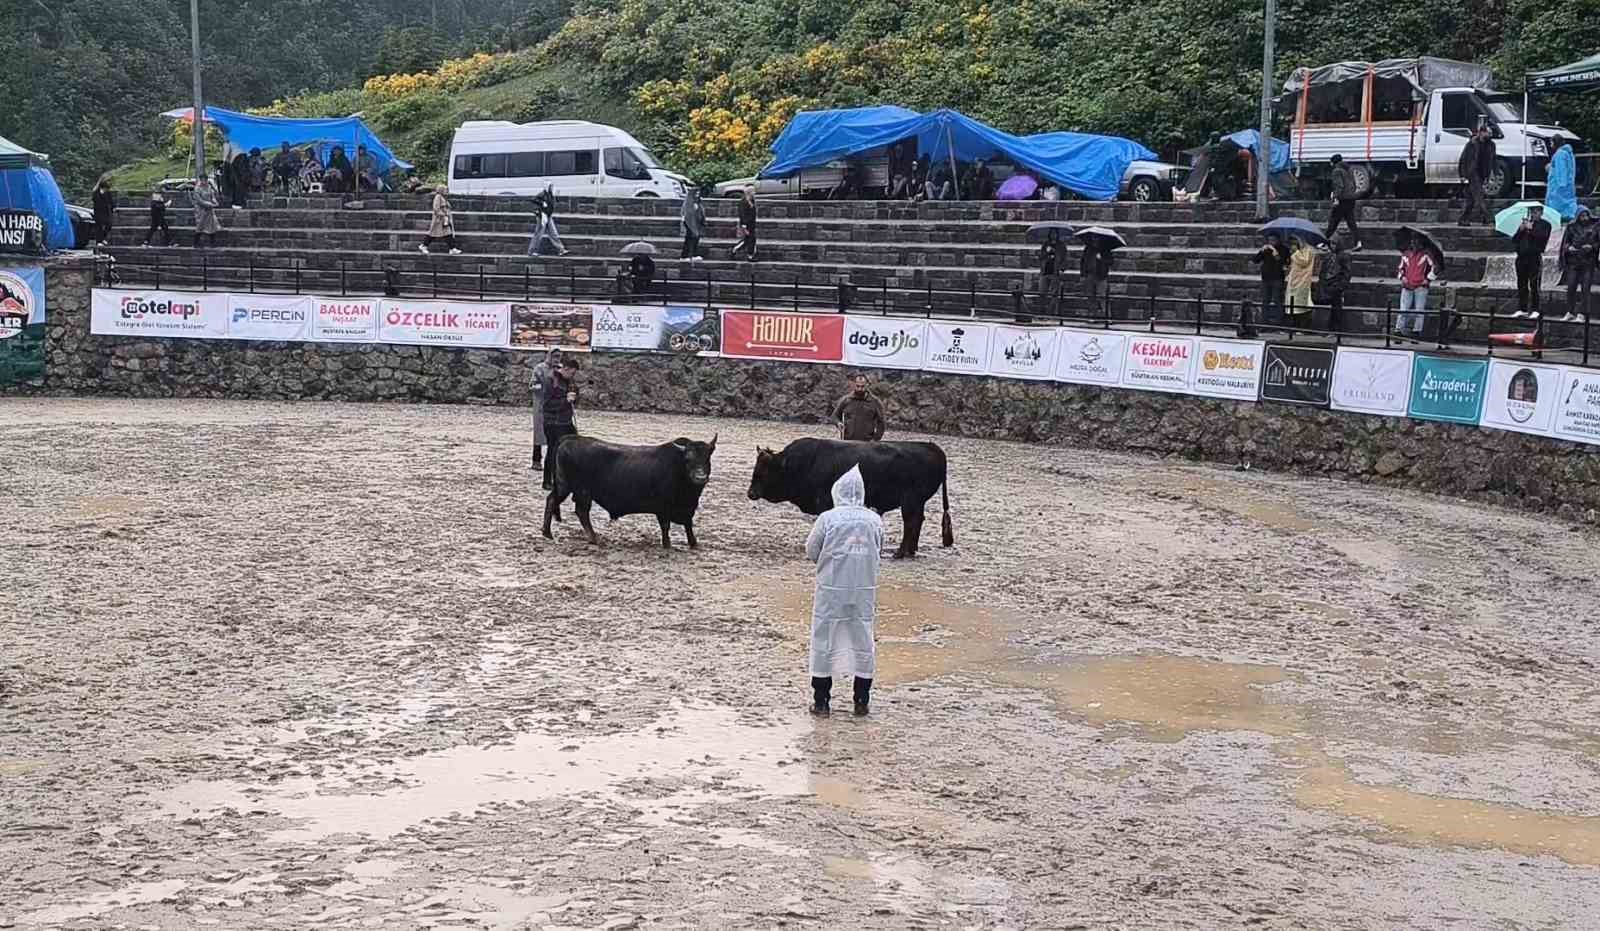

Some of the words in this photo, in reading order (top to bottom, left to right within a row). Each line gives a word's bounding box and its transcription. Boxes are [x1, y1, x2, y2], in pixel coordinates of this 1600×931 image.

[320, 304, 370, 315] BALCAN
[387, 307, 459, 330] ÖZÇELİK
[464, 318, 500, 329] TİCARET
[596, 320, 625, 331] DOĞA
[849, 331, 889, 350] doğa
[1132, 340, 1188, 358] KESİMAL
